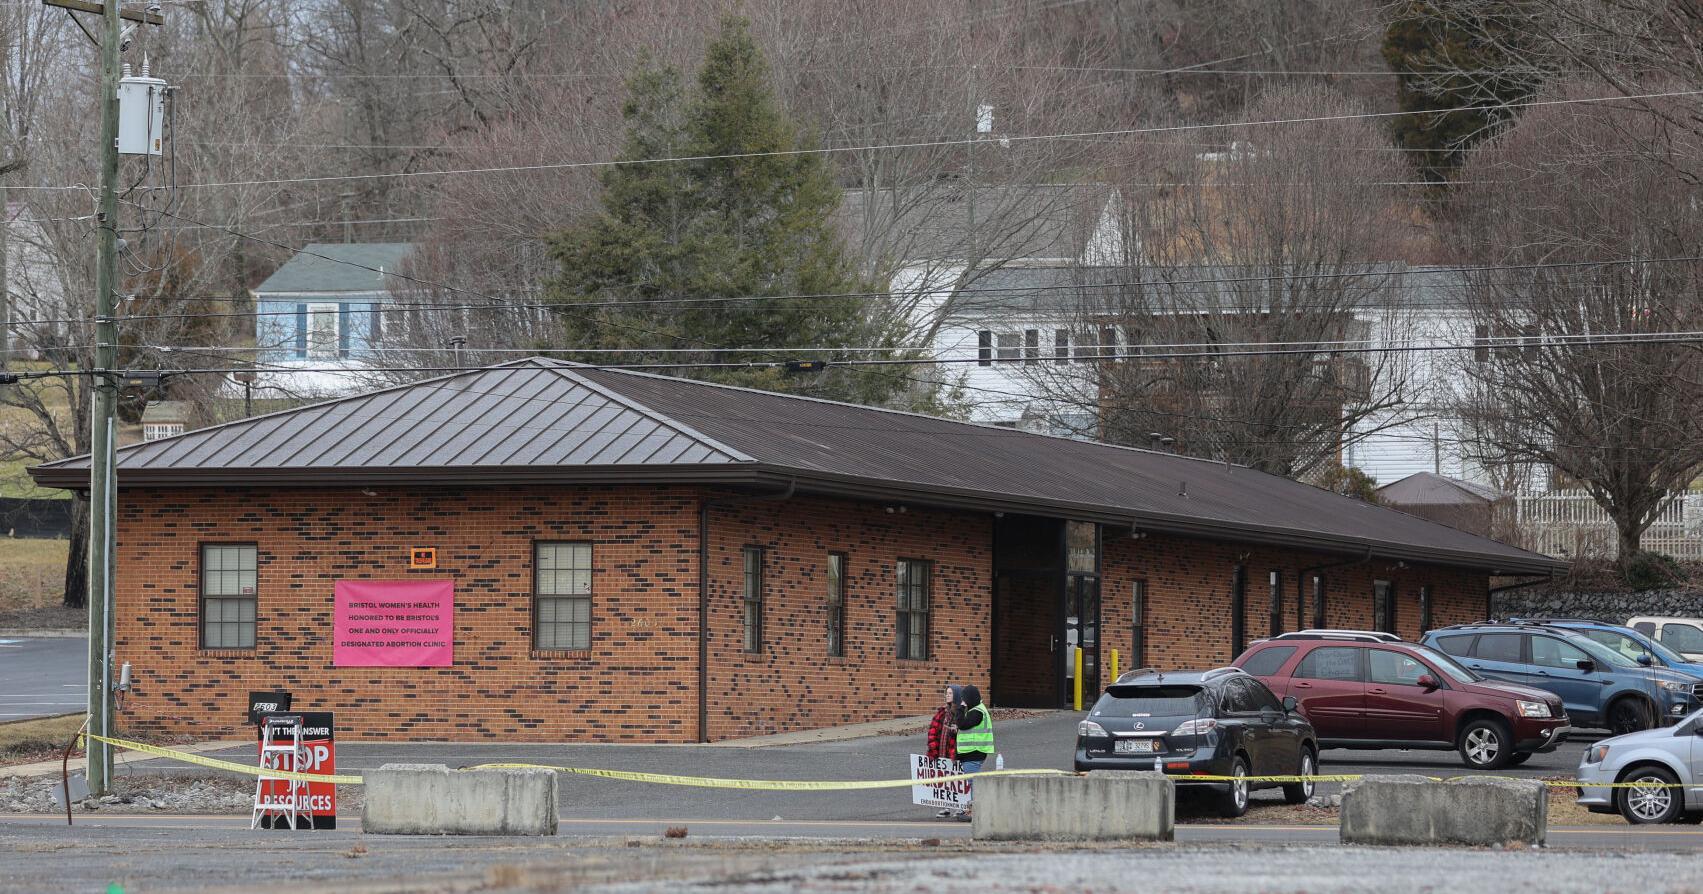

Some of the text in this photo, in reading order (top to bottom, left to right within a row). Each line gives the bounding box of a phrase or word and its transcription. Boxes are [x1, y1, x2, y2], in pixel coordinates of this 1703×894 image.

[918, 756, 947, 770] BABIES
[264, 795, 332, 810] RESOURCES
[934, 789, 958, 802] HERE
